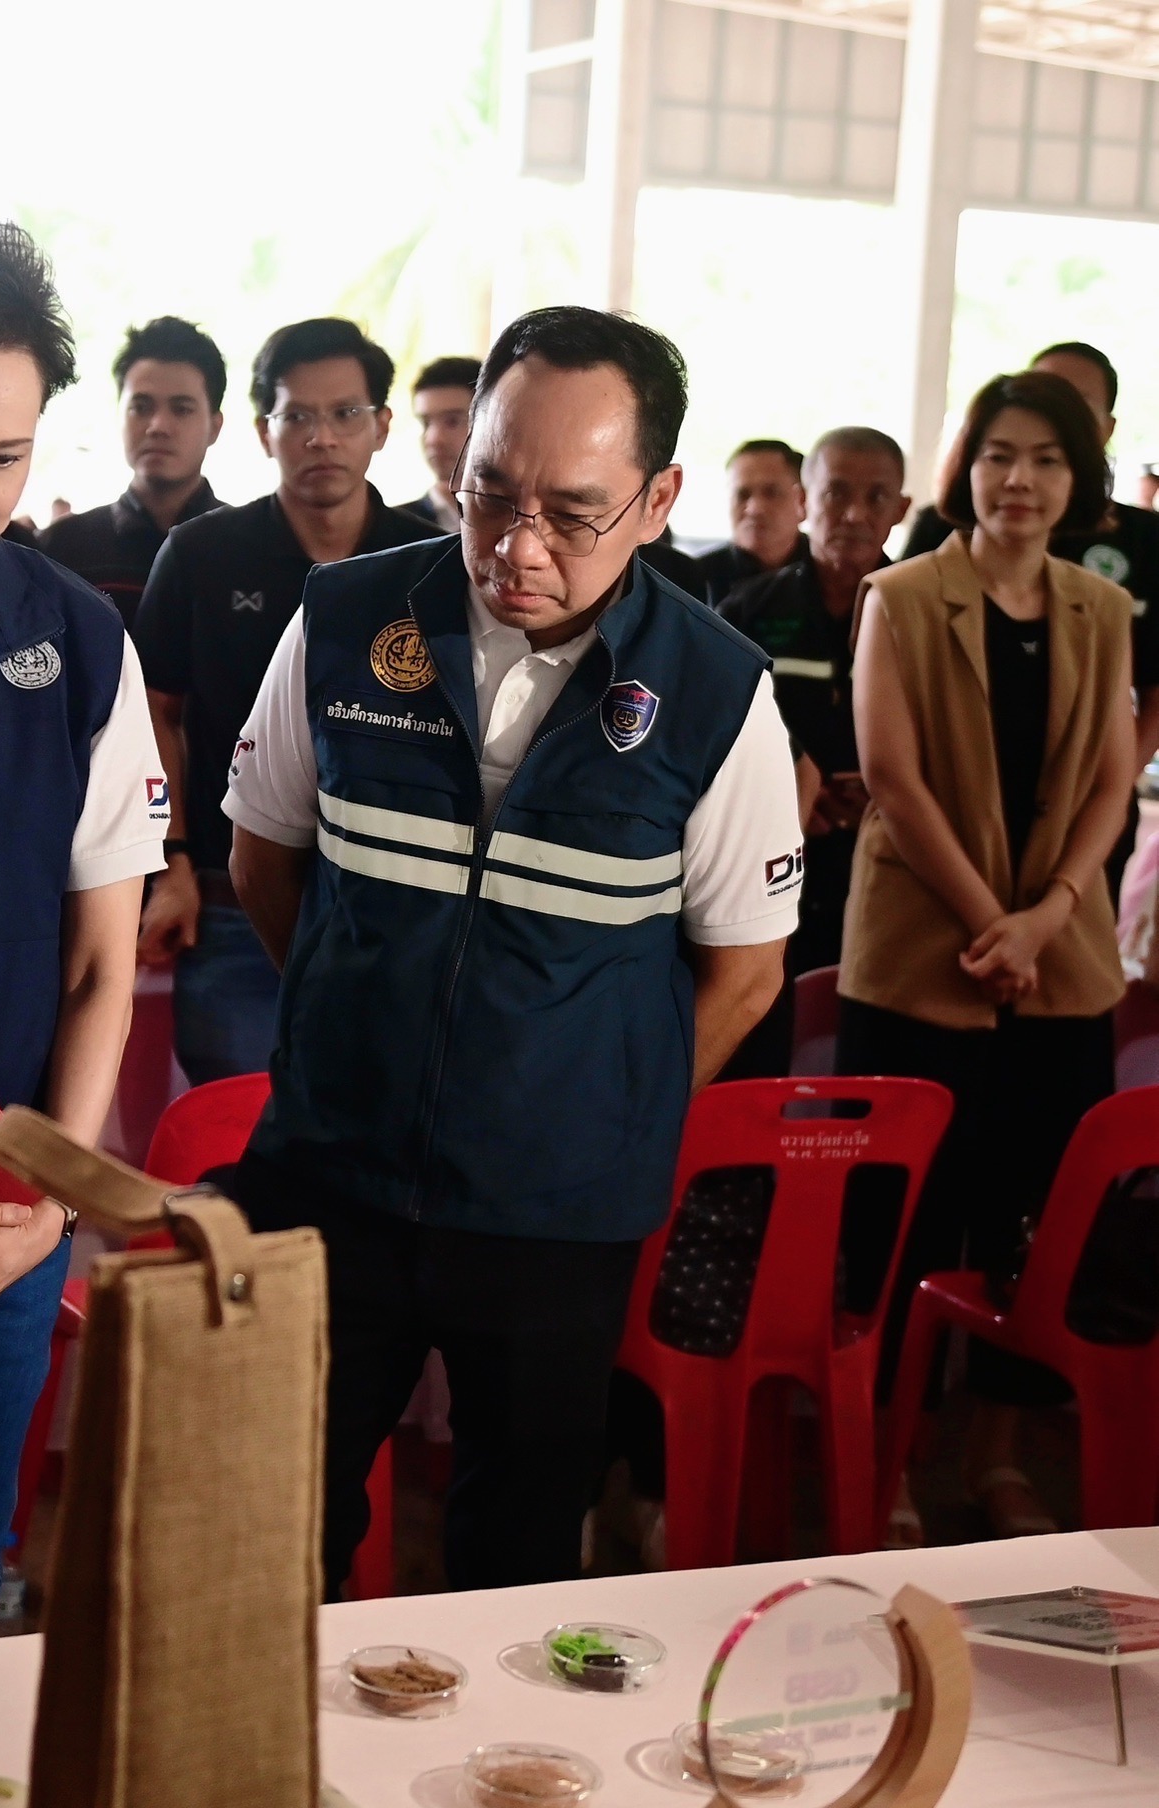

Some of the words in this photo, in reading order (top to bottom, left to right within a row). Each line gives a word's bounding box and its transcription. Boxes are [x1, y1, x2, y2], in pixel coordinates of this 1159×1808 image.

[327, 701, 454, 737] อธิบดีกรมการค้าภายใน
